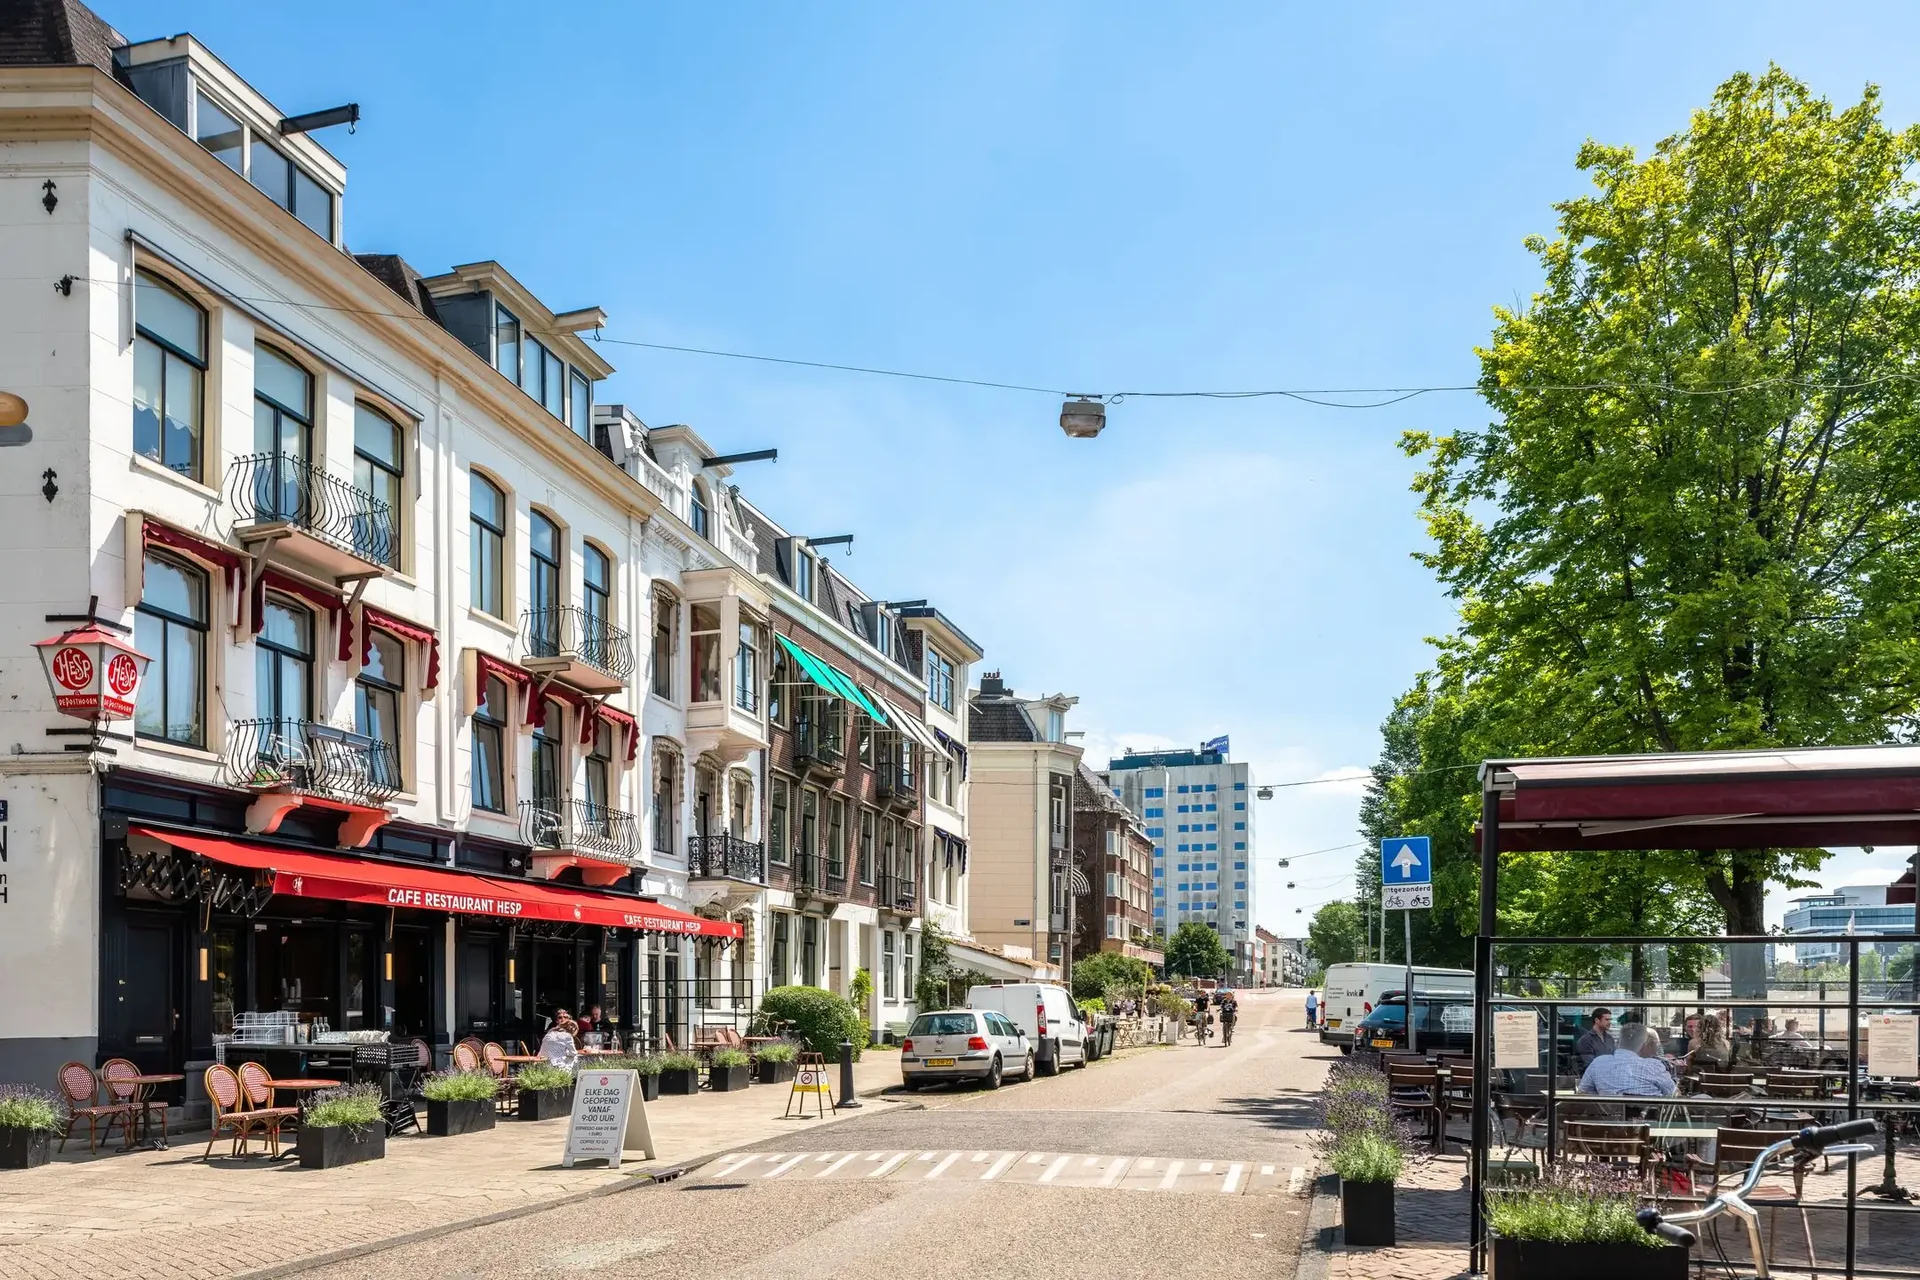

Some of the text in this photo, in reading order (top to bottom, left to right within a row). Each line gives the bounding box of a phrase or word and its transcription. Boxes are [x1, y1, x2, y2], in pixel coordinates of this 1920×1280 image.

[55, 648, 91, 688] HESP
[110, 656, 136, 693] HESP
[388, 888, 522, 915] CAFE RESTAURANT HESP
[624, 914, 701, 932] CAFE RESTAURANT HESP
[582, 1114, 598, 1122] 9:00
